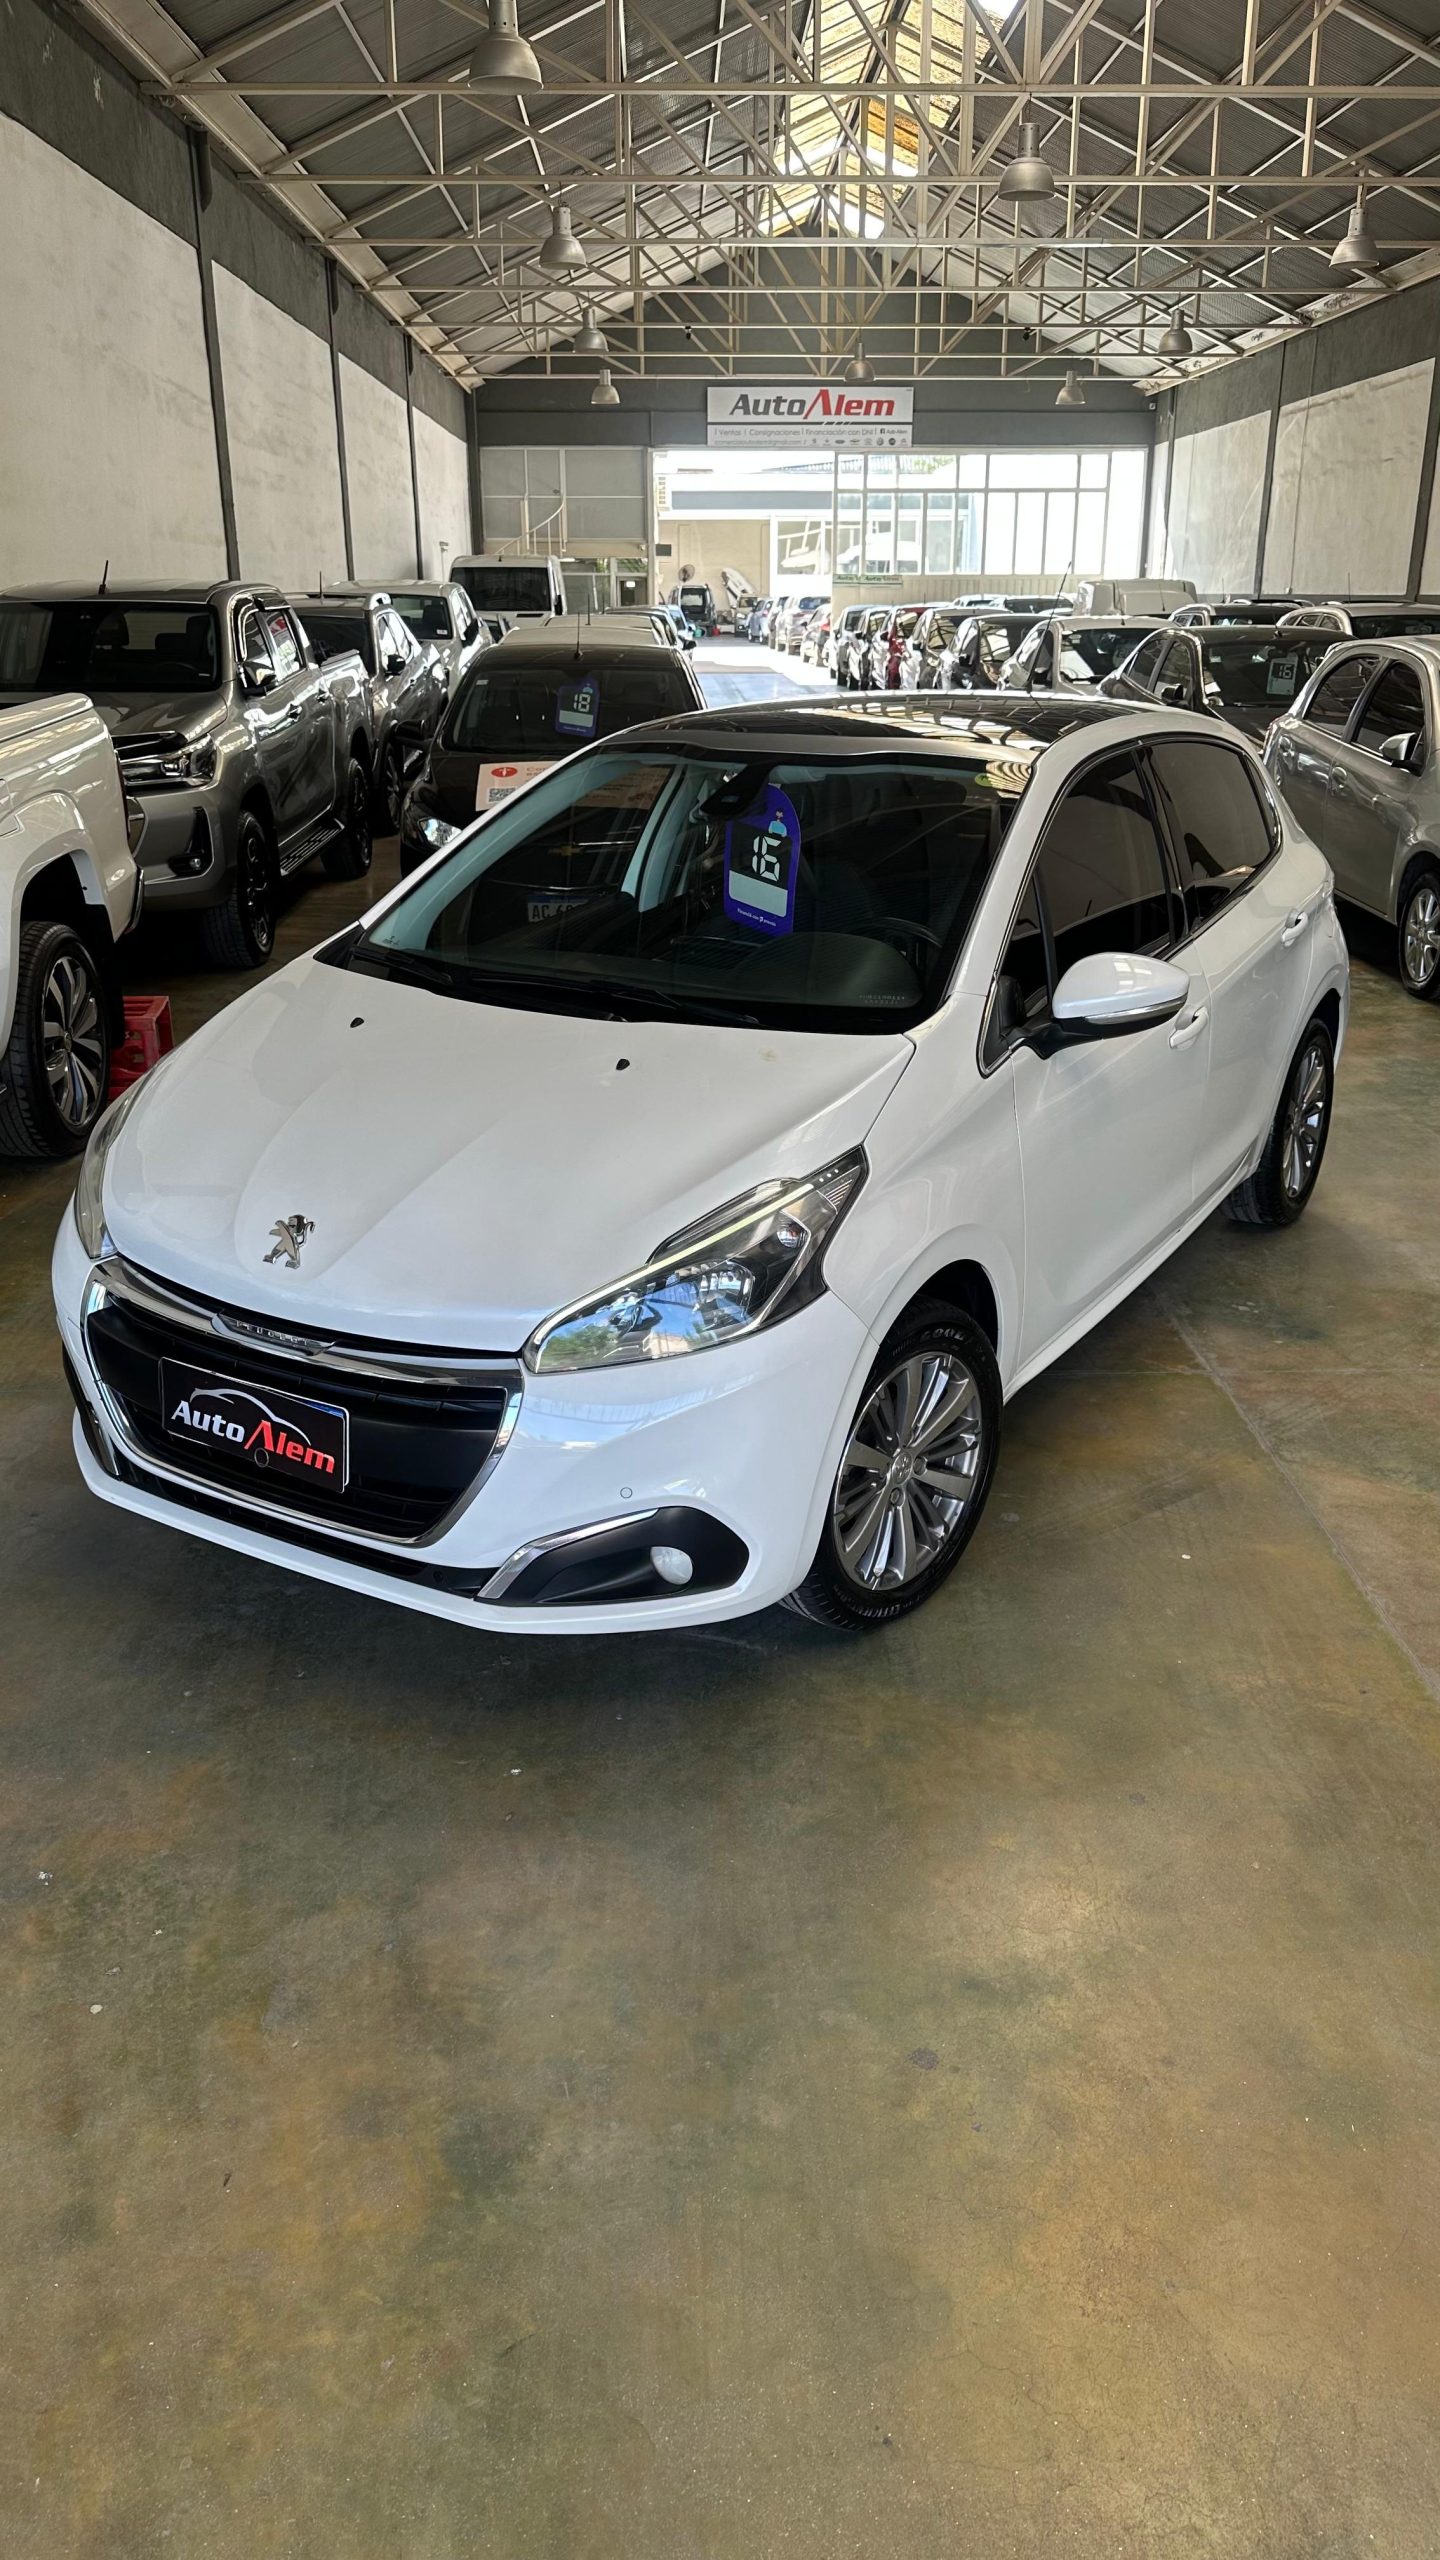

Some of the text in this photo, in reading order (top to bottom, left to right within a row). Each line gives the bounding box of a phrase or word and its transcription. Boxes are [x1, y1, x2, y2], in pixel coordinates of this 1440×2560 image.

[1279, 664, 1292, 679] 16
[573, 693, 591, 713] 18
[751, 835, 781, 882] 16
